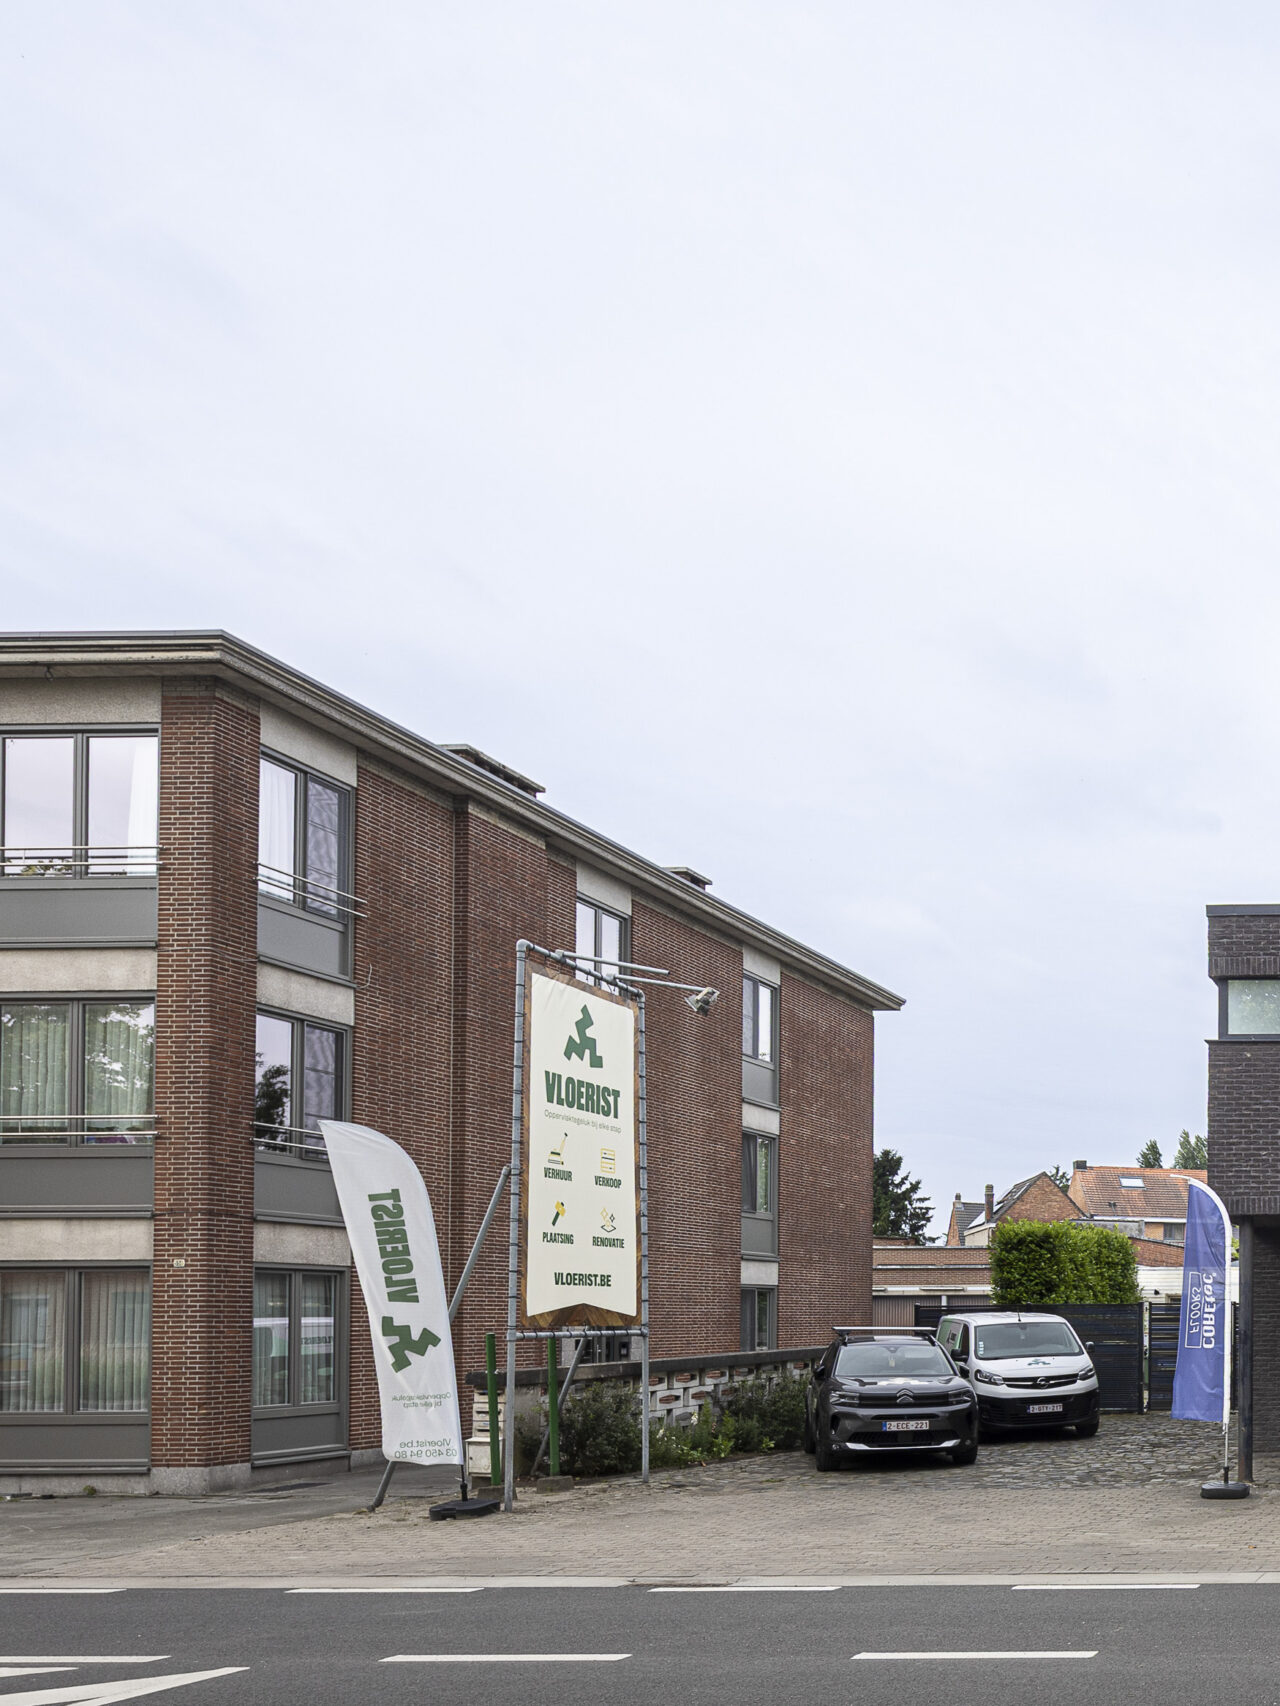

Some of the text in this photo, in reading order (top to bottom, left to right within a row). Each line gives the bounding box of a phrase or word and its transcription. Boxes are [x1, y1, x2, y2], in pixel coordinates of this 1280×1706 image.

[544, 1070, 620, 1119] VLOERIST
[544, 1167, 572, 1181] VERHUUR
[594, 1175, 622, 1188] VERKOOP
[542, 1231, 574, 1245] PLAATSING
[592, 1236, 625, 1249] RENOVATIE
[554, 1271, 612, 1287] VLOERIST.BE
[887, 1421, 928, 1430] 2-ECE-221
